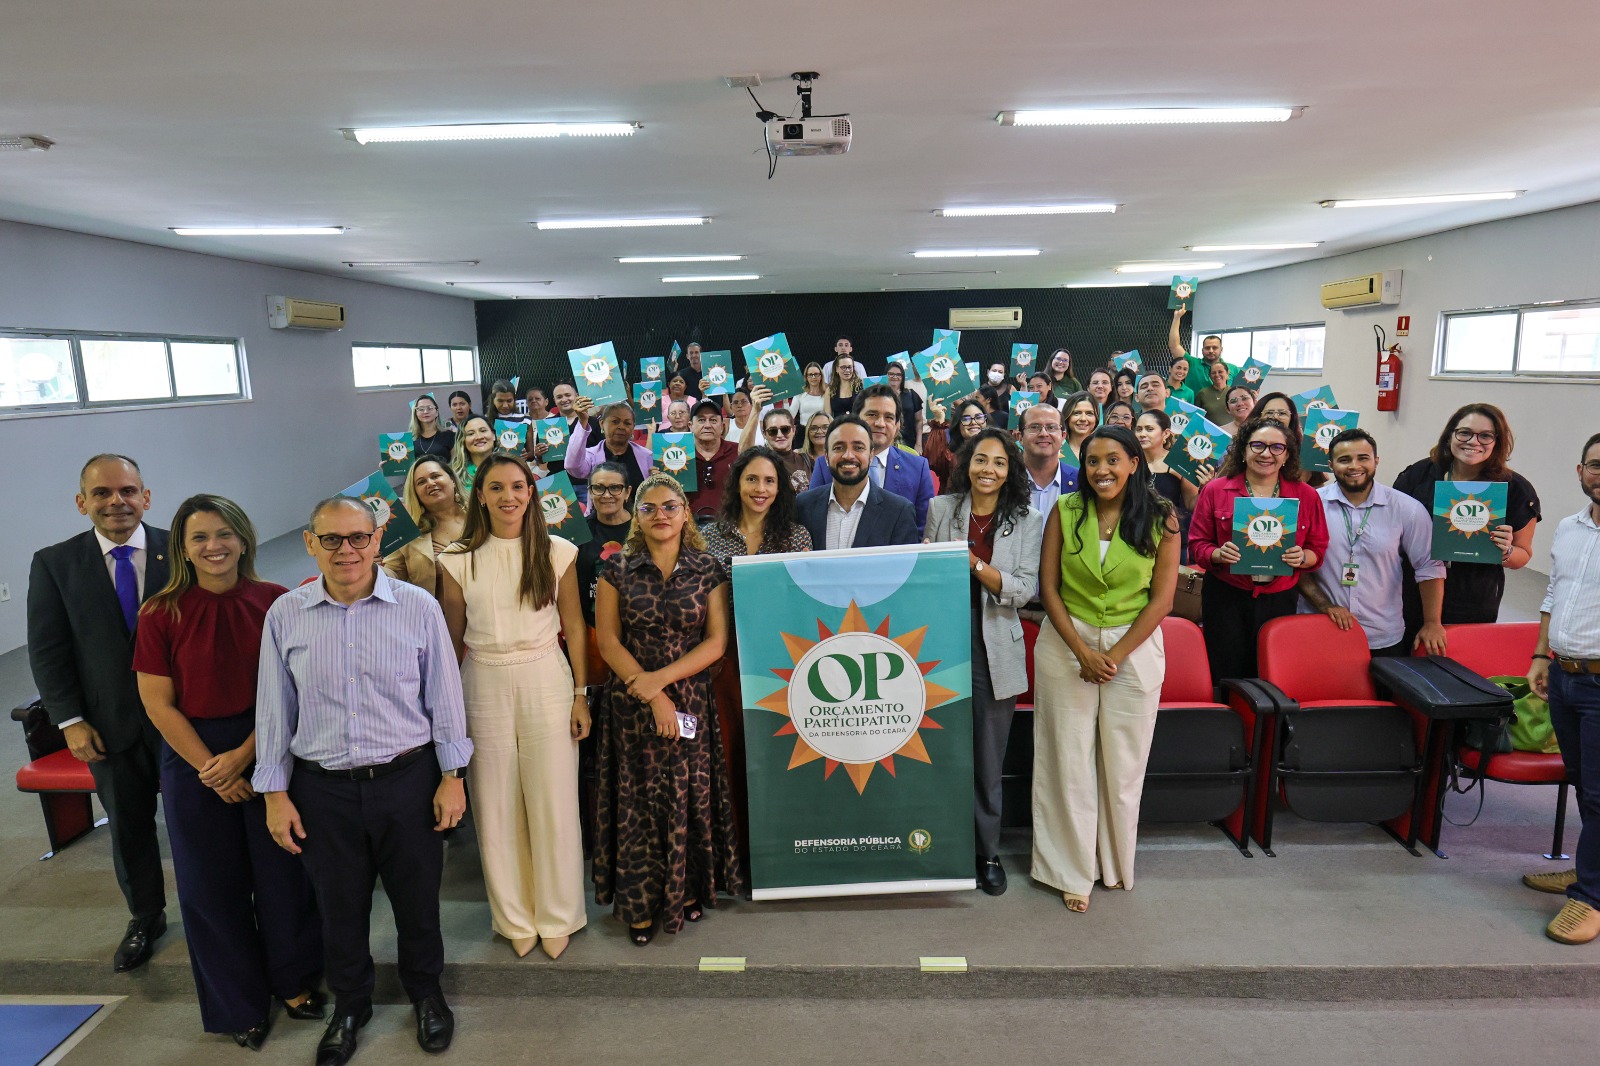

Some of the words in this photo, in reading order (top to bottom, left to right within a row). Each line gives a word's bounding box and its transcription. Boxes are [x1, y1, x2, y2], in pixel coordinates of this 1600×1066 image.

[587, 360, 604, 373] OP
[761, 354, 779, 368] OP
[932, 358, 948, 372] OP
[1248, 368, 1260, 376] OP
[643, 393, 654, 401] OP
[1173, 417, 1189, 426] OP
[503, 433, 516, 441] OP
[548, 429, 560, 437] OP
[1193, 437, 1211, 451] OP
[666, 450, 683, 460] OP
[541, 496, 560, 512] OP
[1456, 504, 1485, 517] OP
[1253, 519, 1279, 532] OP
[808, 652, 905, 703] OP
[809, 703, 905, 718] ORÇAMENTO
[804, 714, 912, 729] PARTICIPATIVO
[882, 727, 907, 735] CEARÁ
[794, 837, 858, 848] DEFENSORIA
[859, 835, 902, 845] PÚBLICA
